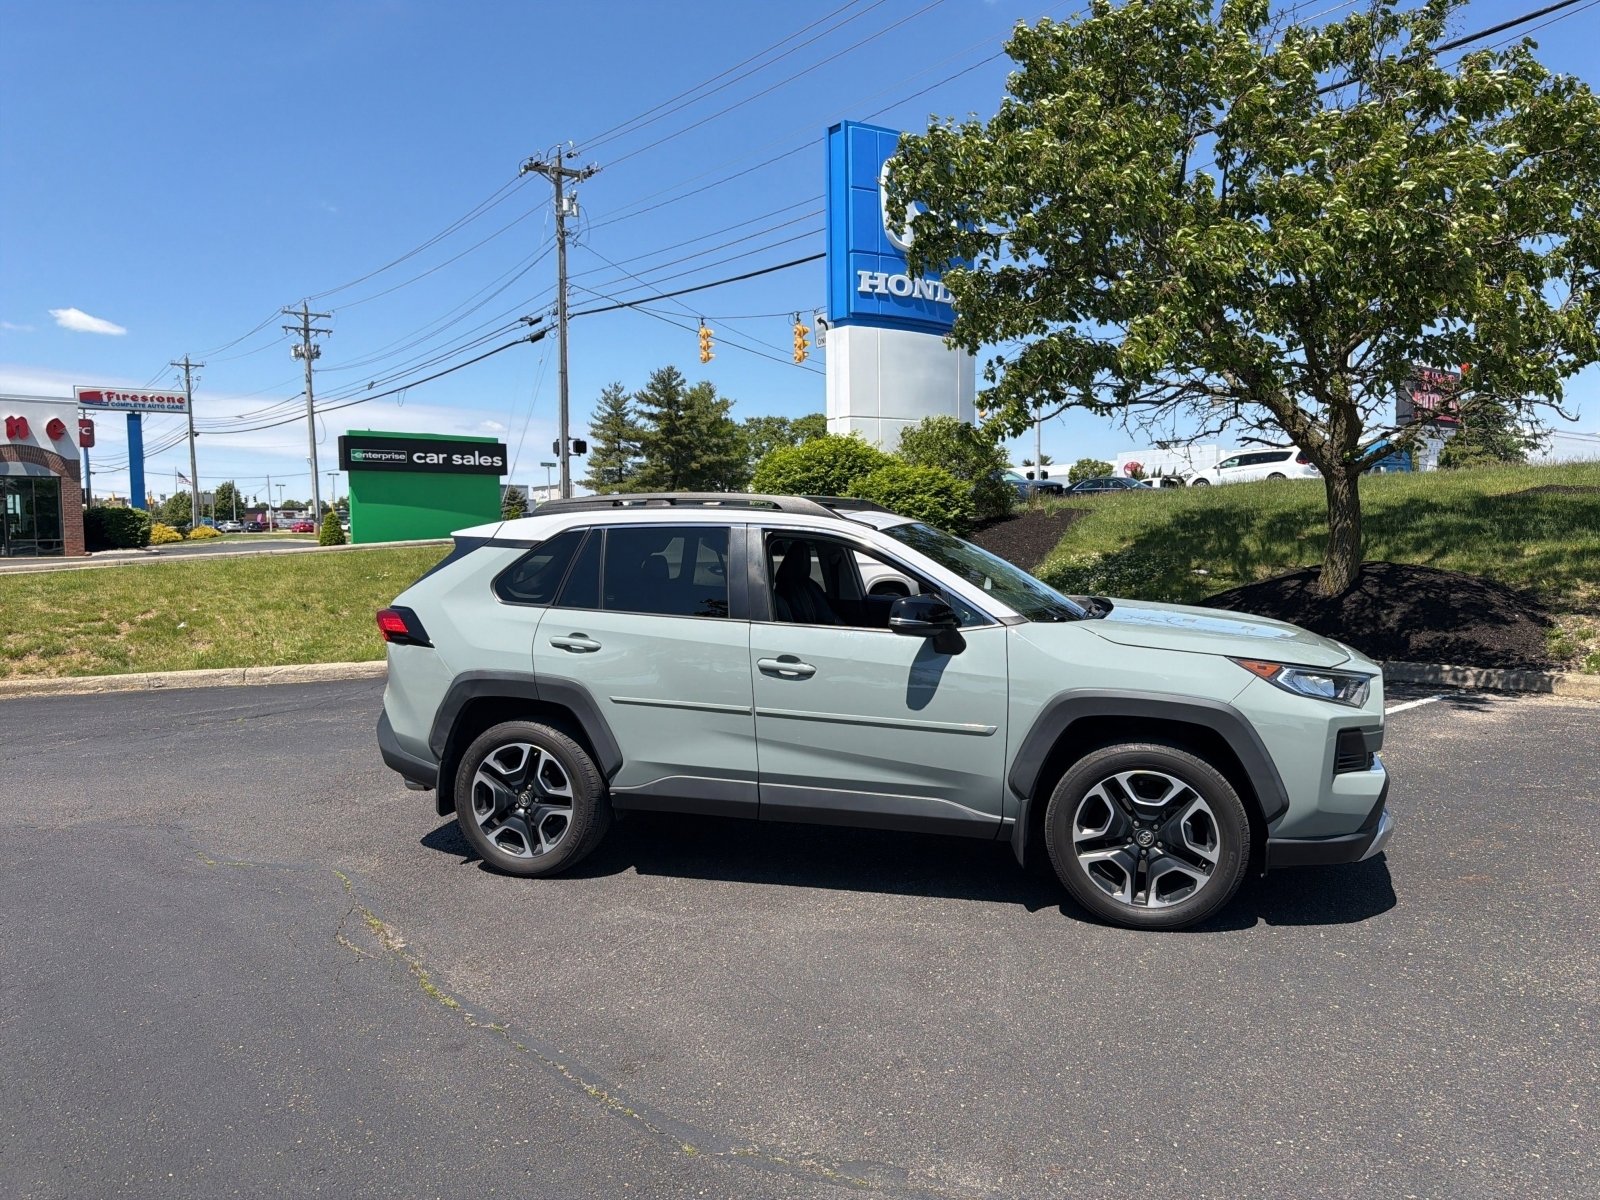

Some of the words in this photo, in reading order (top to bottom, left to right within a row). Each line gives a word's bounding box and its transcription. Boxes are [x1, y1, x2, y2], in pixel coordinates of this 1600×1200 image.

[857, 270, 956, 304] HOND
[103, 391, 186, 404] Firestone
[110, 401, 146, 409] COMPLETE
[353, 451, 406, 461] enterprise
[412, 451, 448, 464] car
[452, 450, 503, 467] sales
